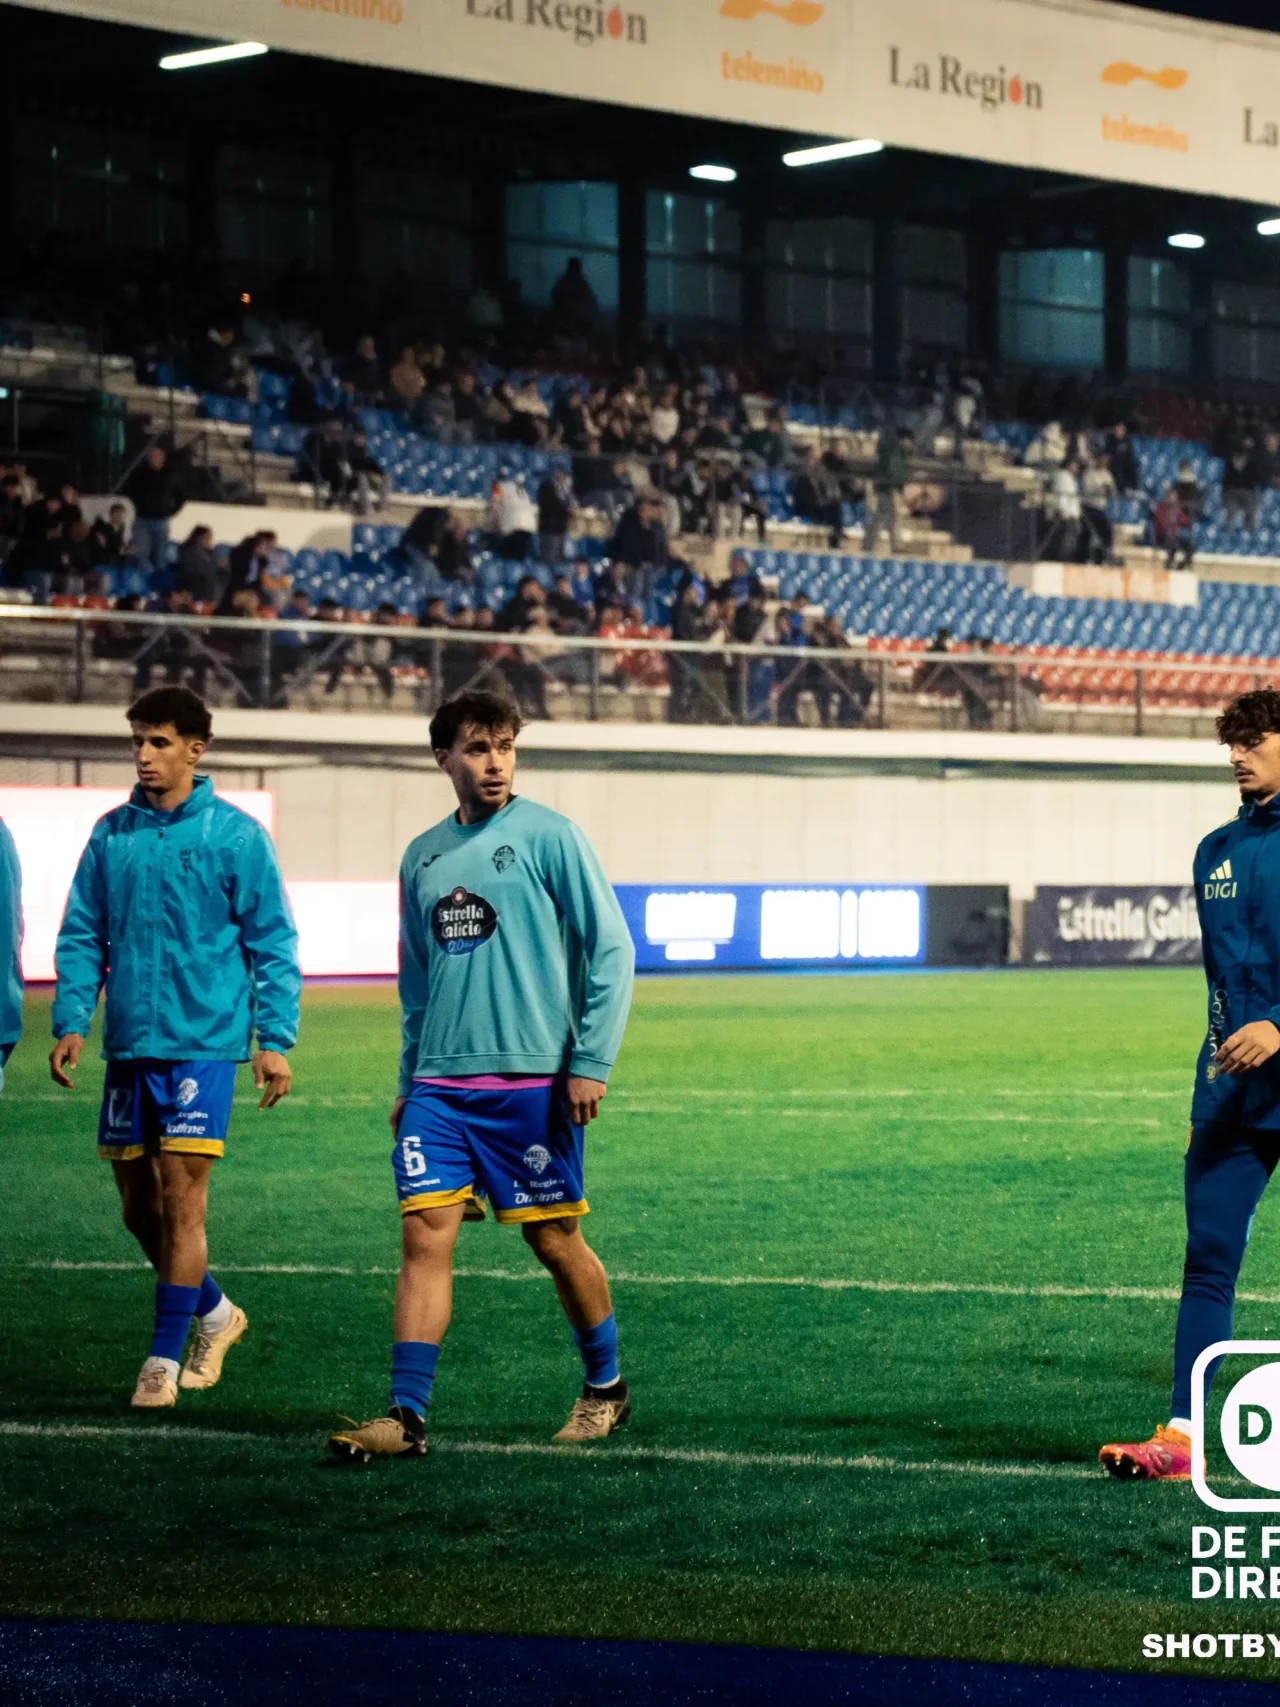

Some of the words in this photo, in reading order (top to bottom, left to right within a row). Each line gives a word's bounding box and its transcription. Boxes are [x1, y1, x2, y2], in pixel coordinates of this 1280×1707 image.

[888, 44, 931, 92] La
[1243, 106, 1278, 148] La
[1204, 881, 1237, 900] DIGI
[438, 904, 484, 922] Estrella
[1057, 896, 1146, 942] Estrella
[107, 1087, 132, 1127] 12
[402, 1135, 427, 1177] 6
